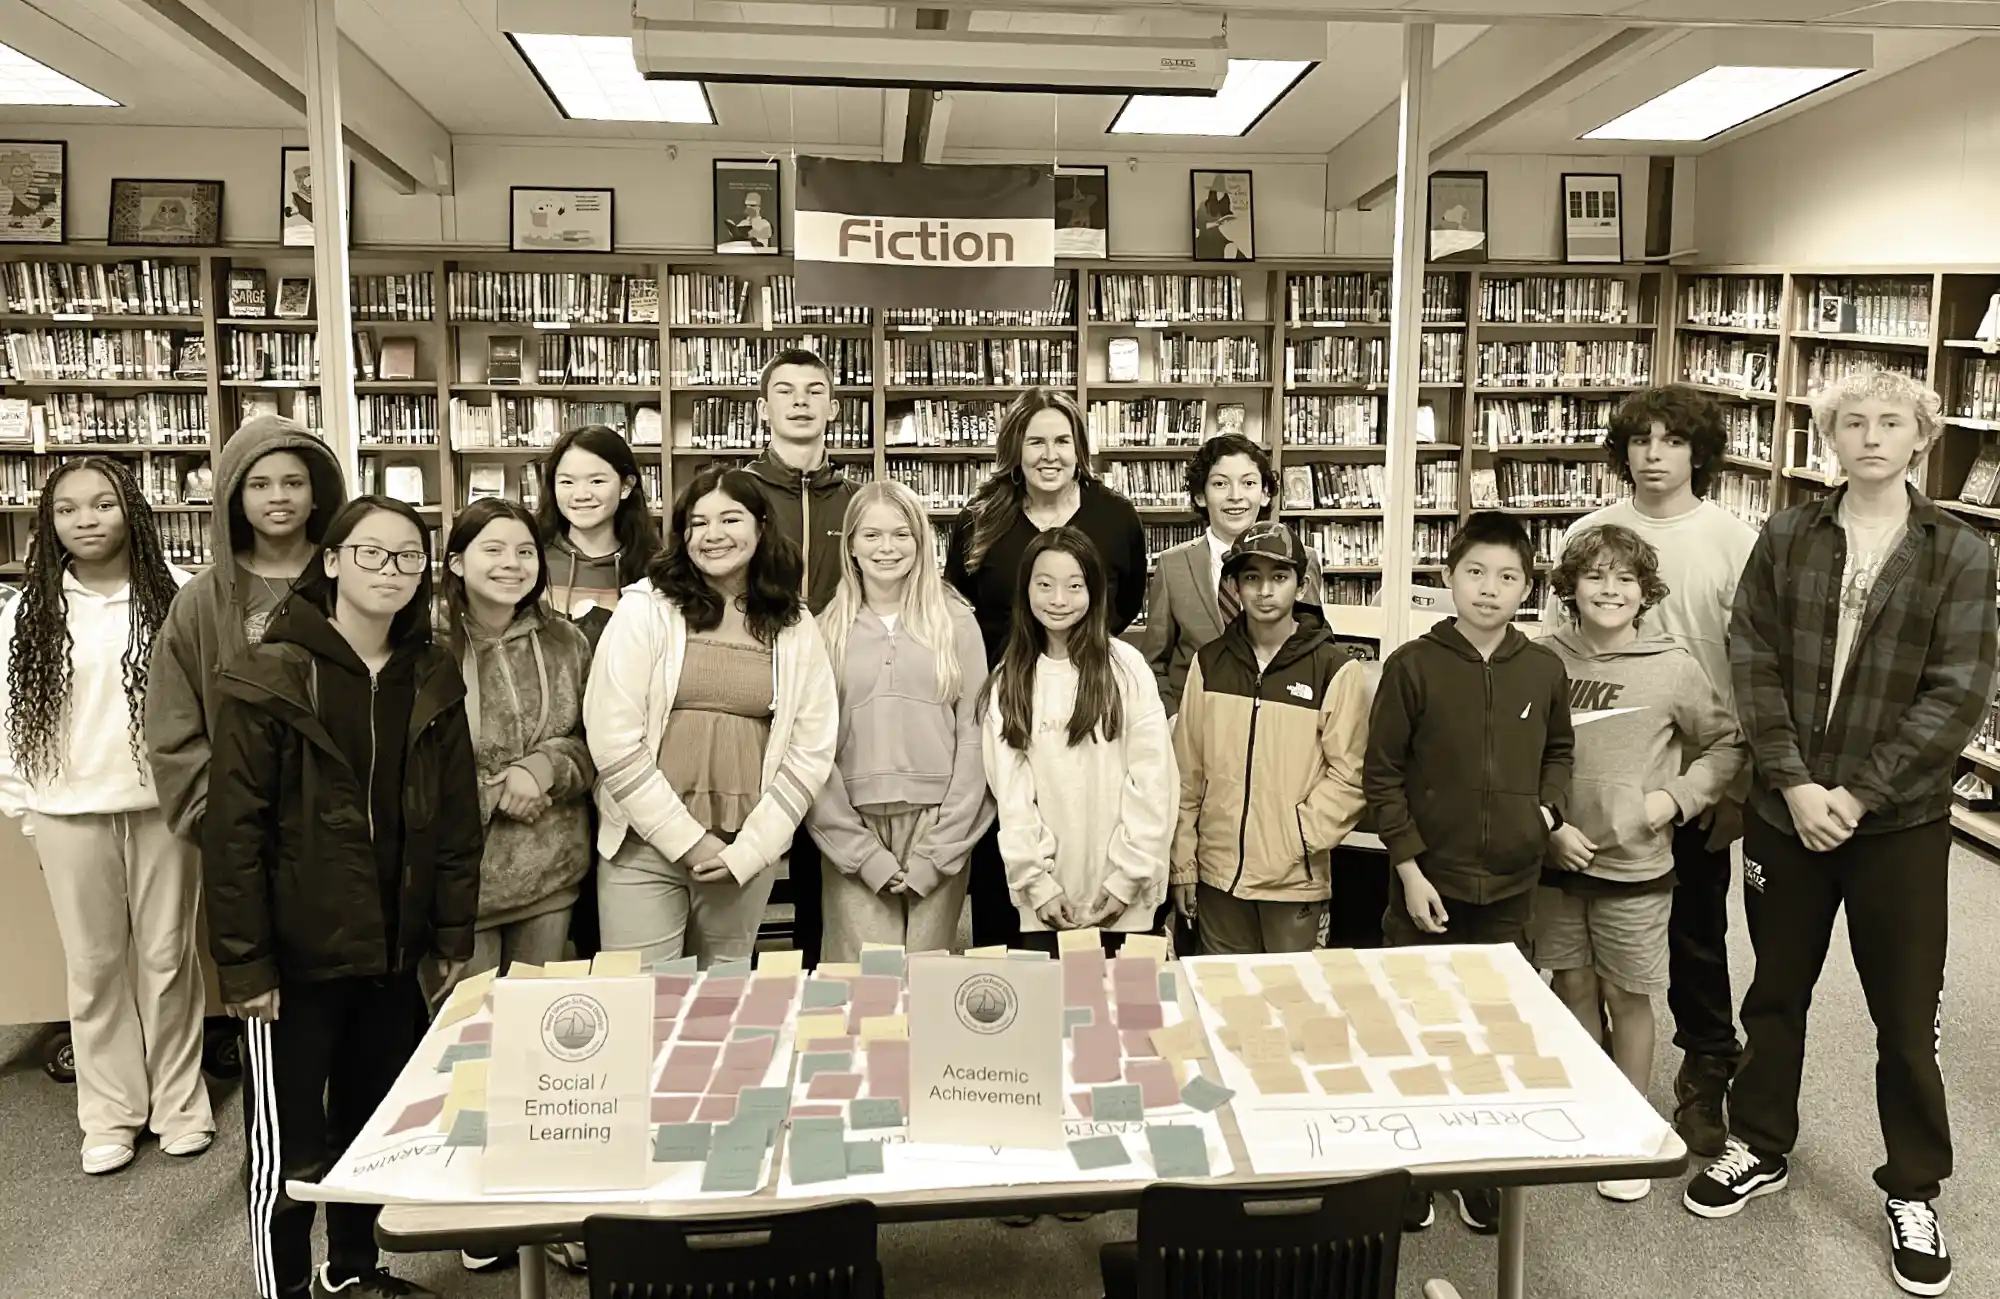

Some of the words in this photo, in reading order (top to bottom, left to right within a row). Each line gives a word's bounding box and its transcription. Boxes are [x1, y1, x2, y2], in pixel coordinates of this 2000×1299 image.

[838, 218, 1014, 262] Fiction
[231, 289, 266, 304] SARGE
[537, 1073, 595, 1091] Social
[942, 1063, 1029, 1084] Academic
[928, 1085, 1042, 1106] Achievement
[524, 1098, 618, 1116] Emotional
[529, 1123, 611, 1144] Learning
